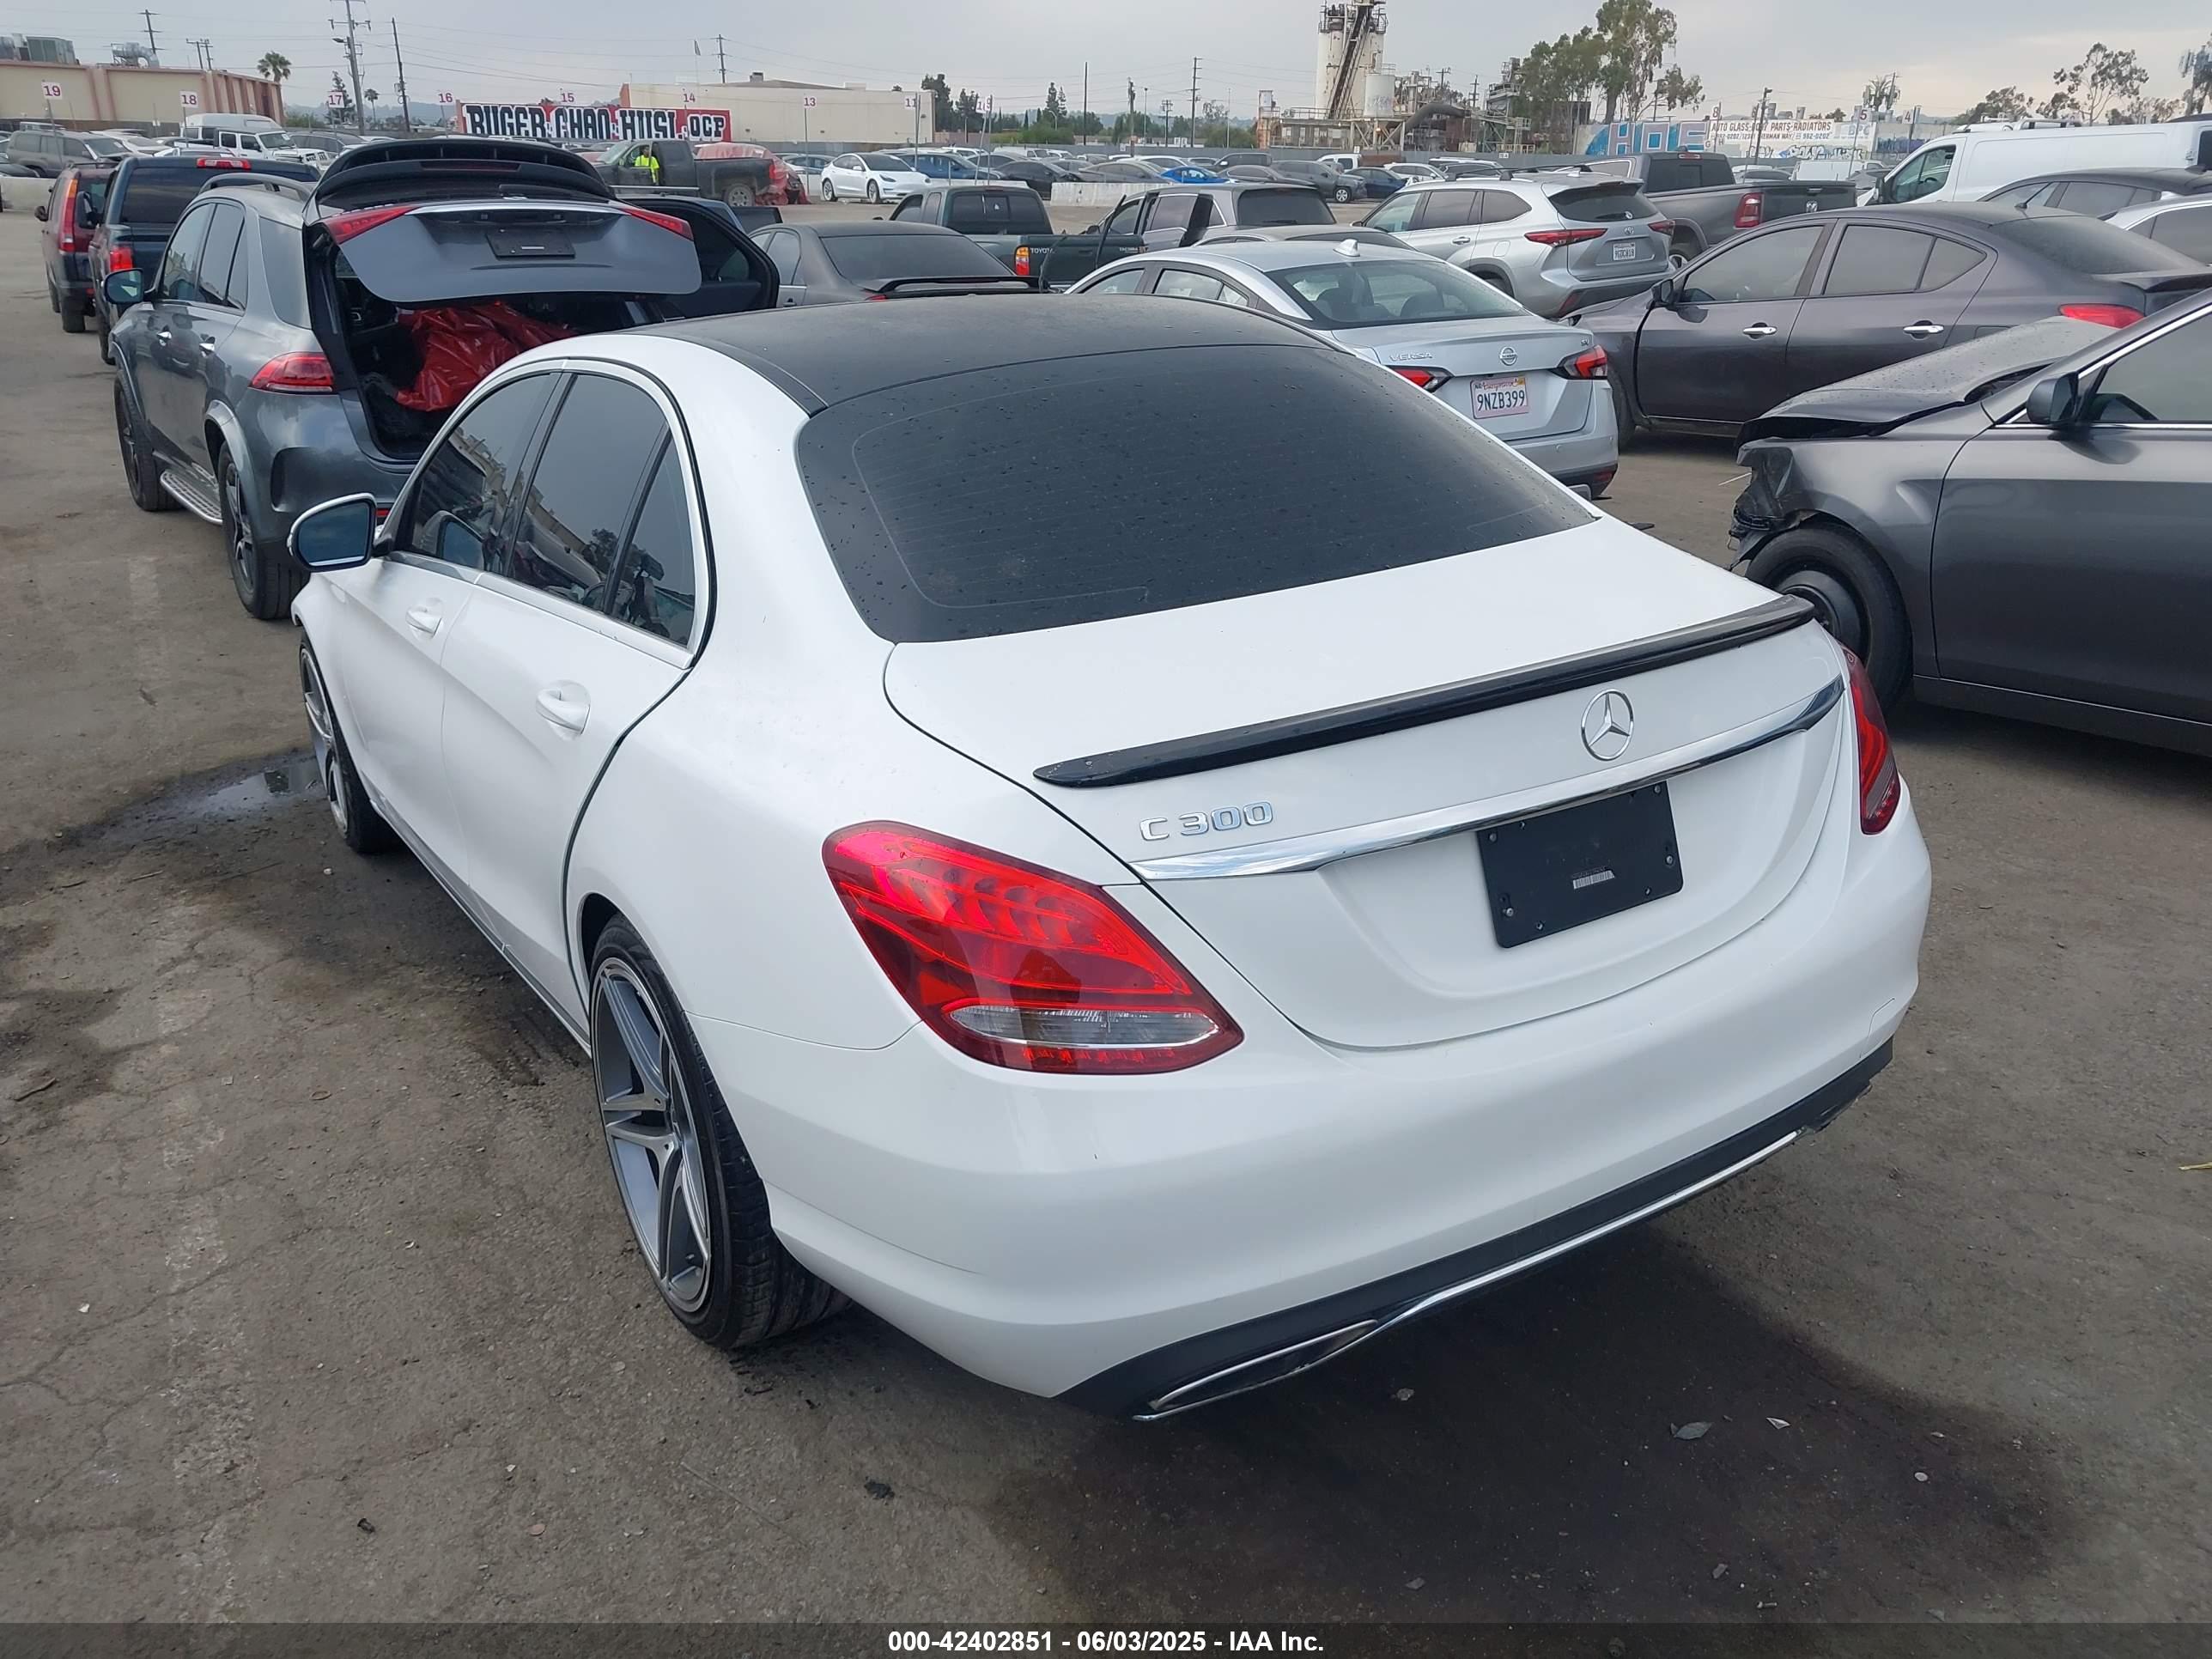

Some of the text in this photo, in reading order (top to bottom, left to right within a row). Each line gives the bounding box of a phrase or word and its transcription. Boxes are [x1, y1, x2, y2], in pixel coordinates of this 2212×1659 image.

[44, 85, 61, 97] 19
[181, 94, 197, 105] 18
[329, 94, 343, 106] 17
[439, 92, 453, 103] 16
[561, 92, 574, 103] 15
[683, 92, 696, 103] 14
[804, 97, 817, 106] 13
[906, 98, 916, 107] 11
[1712, 106, 1719, 118] 8
[1860, 110, 1867, 120] 5
[1904, 112, 1911, 122] 4
[689, 114, 726, 138] OCP
[1712, 122, 1728, 131] AUTO
[1705, 140, 1711, 149] G
[1477, 389, 1526, 411] 9NZB399
[1139, 801, 1274, 842] C 300
